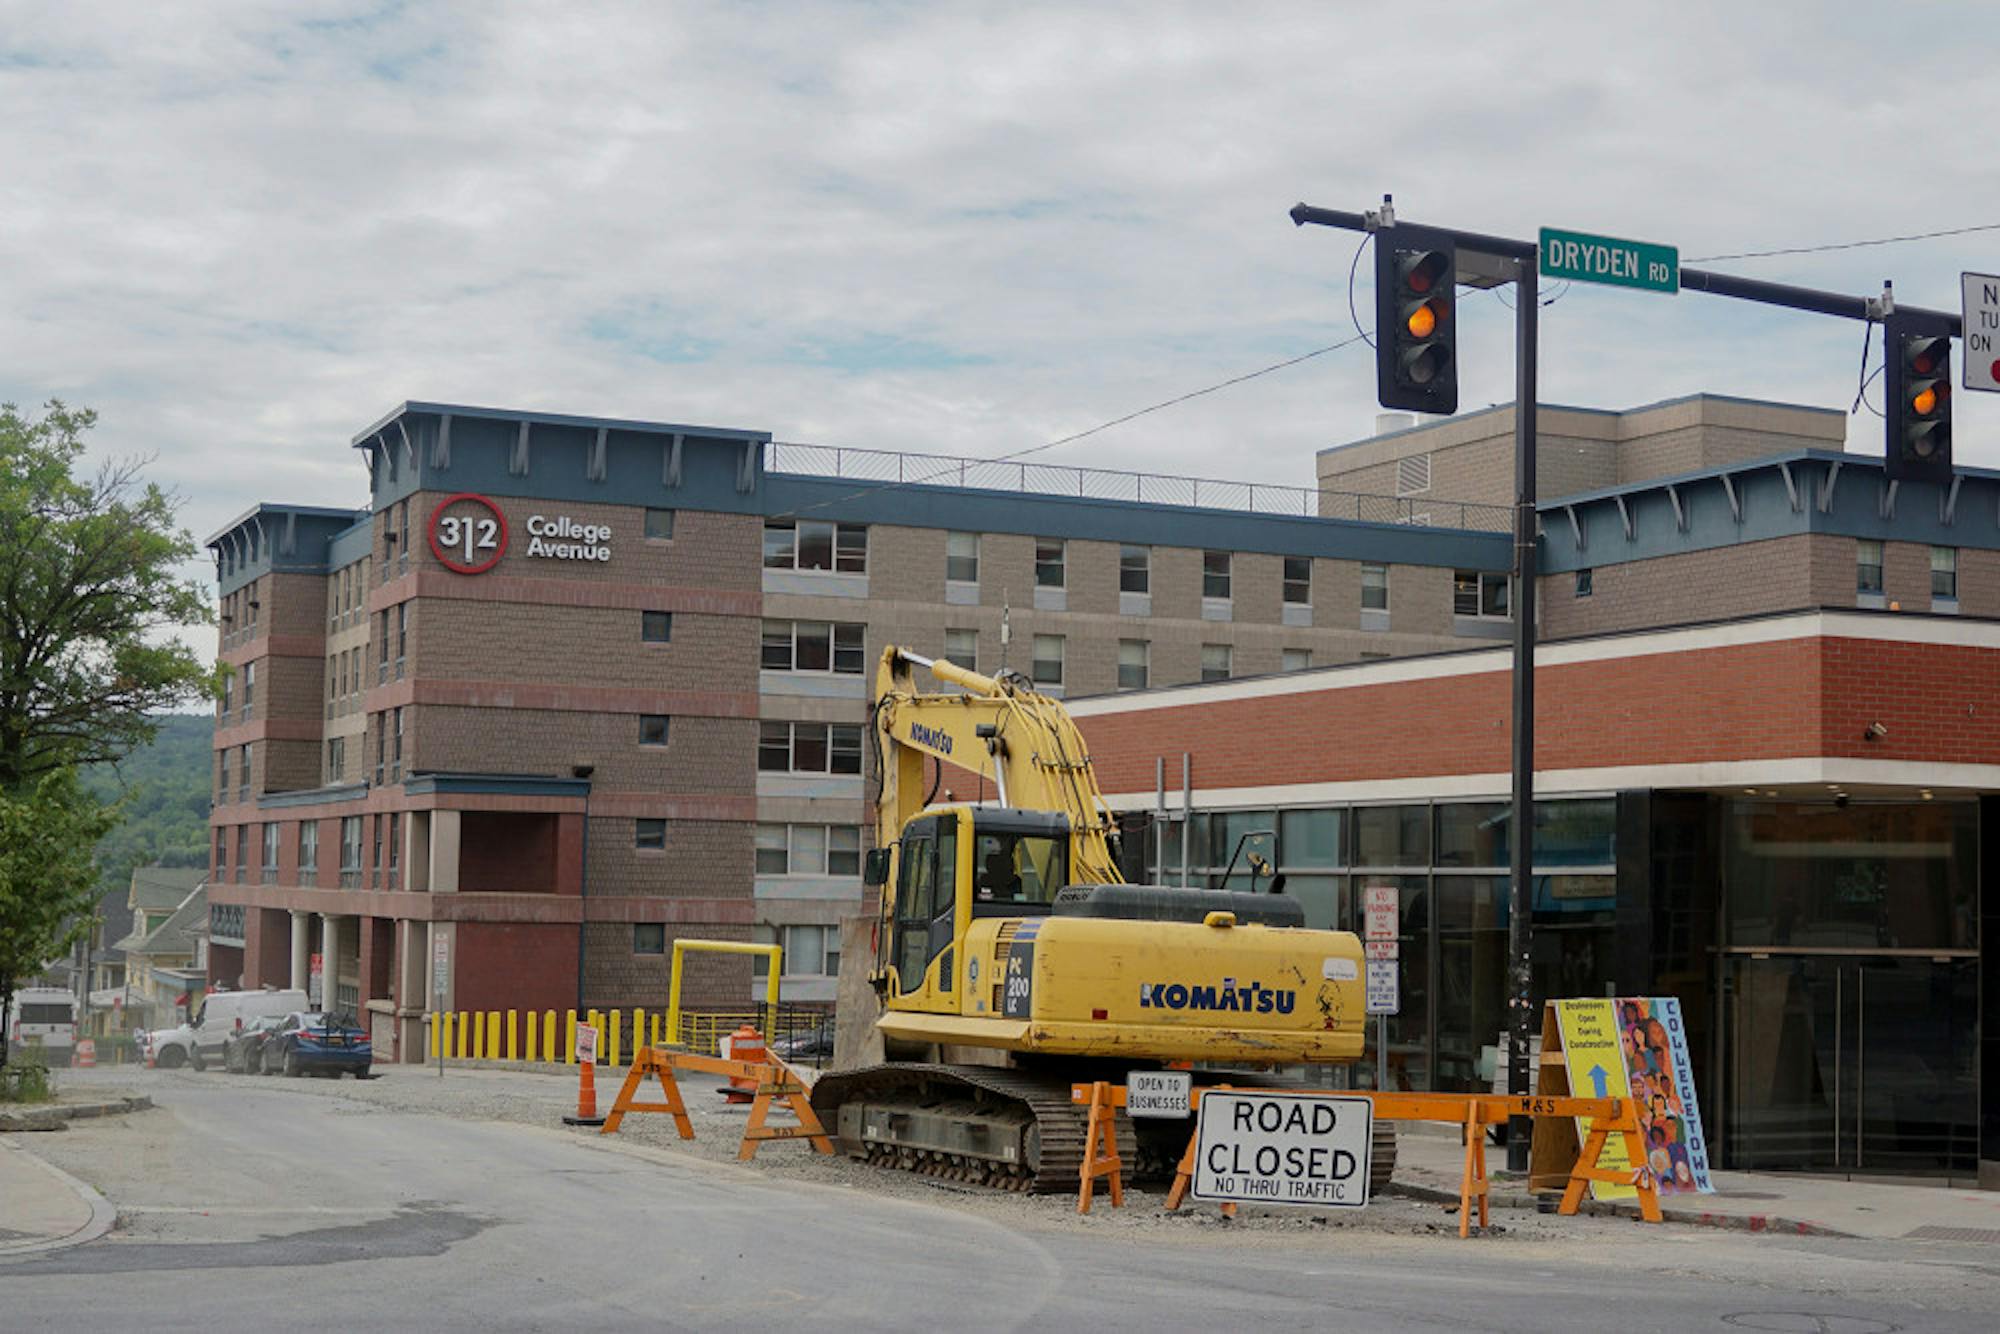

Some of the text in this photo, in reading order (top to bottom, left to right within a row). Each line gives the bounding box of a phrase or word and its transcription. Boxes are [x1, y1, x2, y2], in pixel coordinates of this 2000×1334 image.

[1548, 238, 1669, 283] DRYDEN RD
[1970, 333, 1991, 352] ON
[439, 516, 497, 564] 312
[526, 515, 612, 545] College
[526, 536, 612, 561] Avenue
[911, 721, 953, 755] KOMATSU
[1007, 977, 1029, 998] 200
[1140, 980, 1296, 1014] KOMATSU
[1137, 1077, 1163, 1091] OPEN
[1666, 1001, 1710, 1190] COLLEGETOWN
[1129, 1095, 1187, 1111] BUSINESSES
[1234, 1101, 1337, 1135] ROAD
[1208, 1143, 1357, 1181] CLOSED
[1215, 1177, 1345, 1200] NO THRU TRAFFIC
